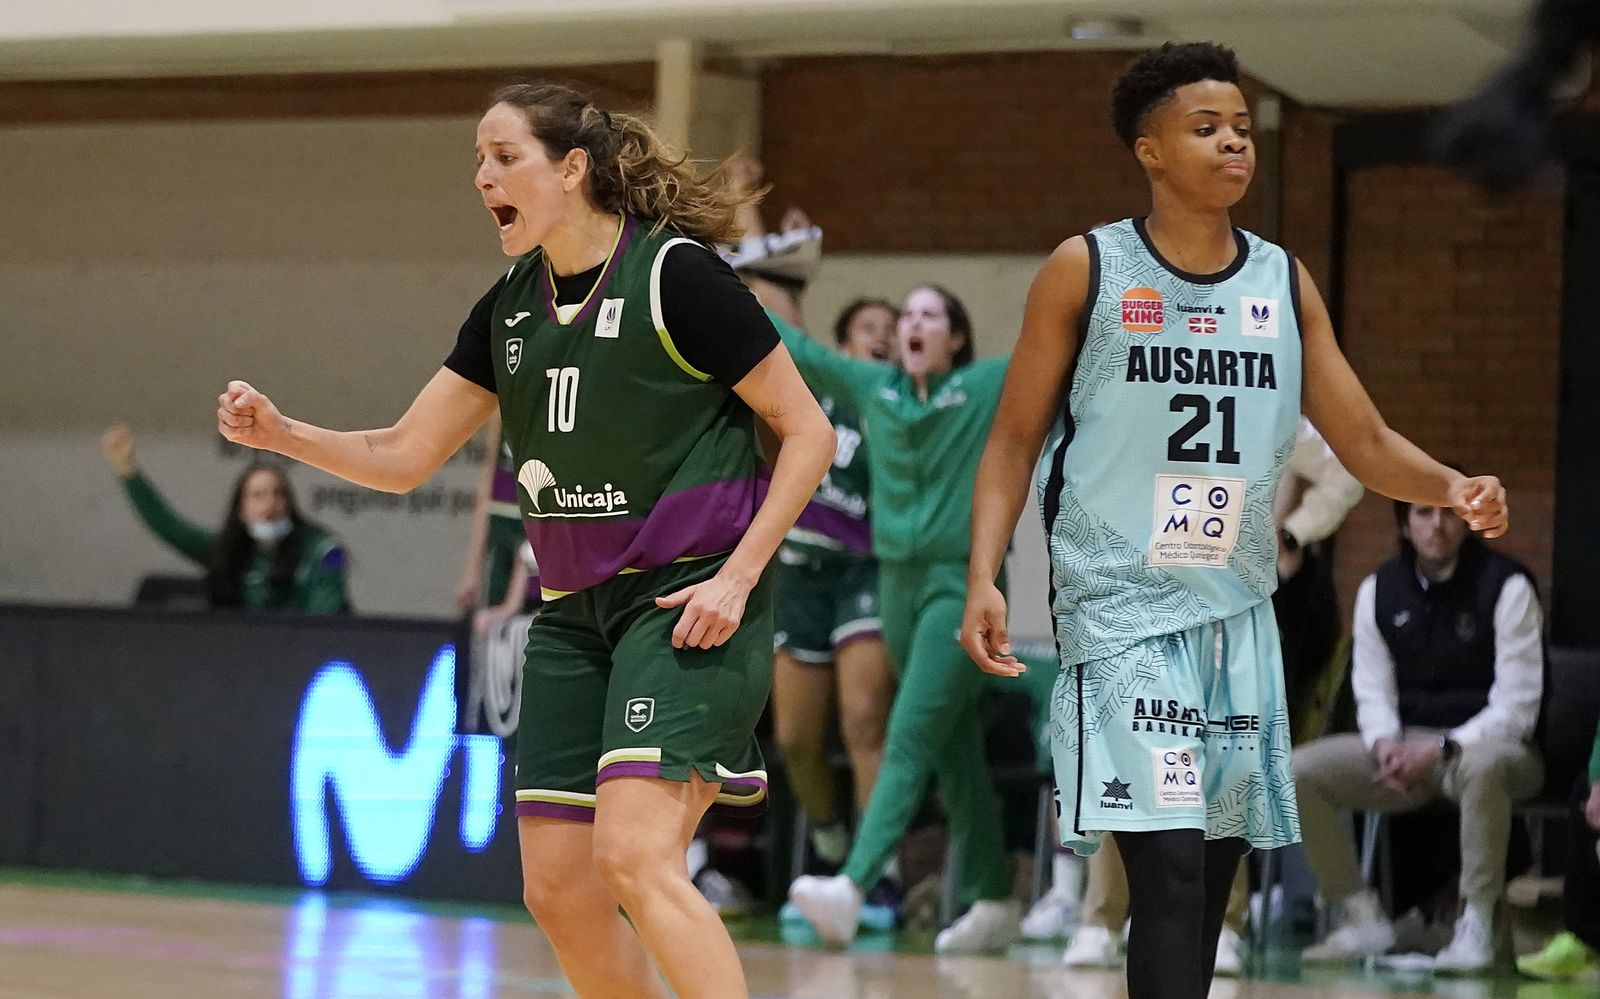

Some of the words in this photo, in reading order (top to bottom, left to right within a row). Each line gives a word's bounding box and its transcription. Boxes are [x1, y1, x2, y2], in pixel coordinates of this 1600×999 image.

[1121, 300, 1163, 310] BURGER
[1176, 303, 1213, 313] luanvi
[1122, 310, 1164, 324] KING
[1125, 345, 1277, 390] AUSARTA
[545, 366, 580, 433] 10
[1168, 393, 1241, 465] 21
[553, 482, 628, 512] Unicaja
[1100, 800, 1134, 810] luanvi
